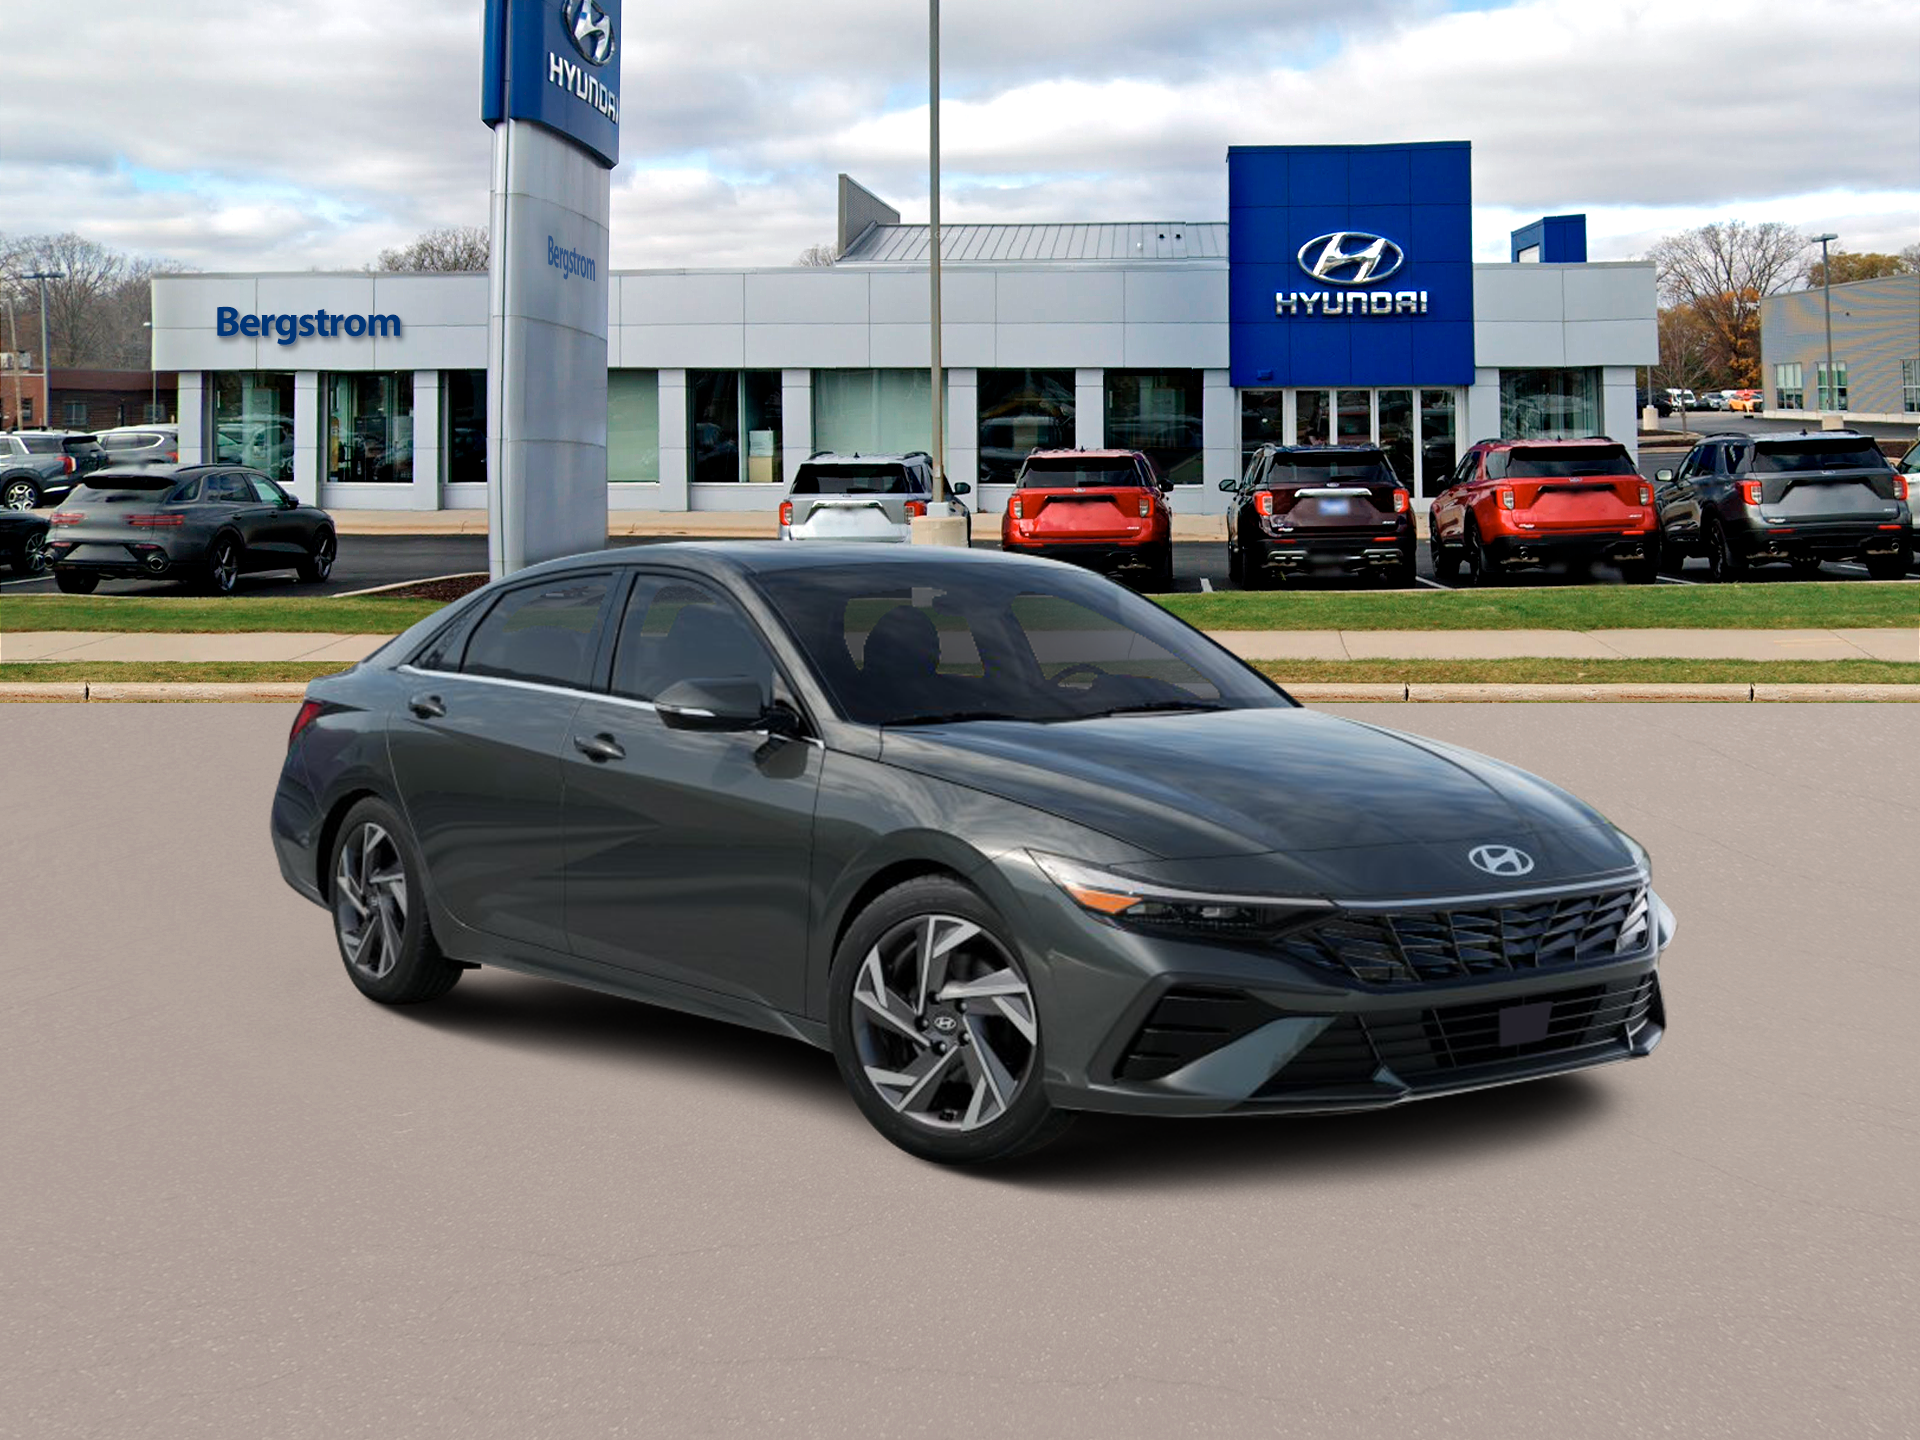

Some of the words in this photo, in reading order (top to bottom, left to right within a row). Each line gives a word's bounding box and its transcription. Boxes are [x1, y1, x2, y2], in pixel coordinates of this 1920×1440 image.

[548, 51, 618, 124] HYUNDAI
[547, 235, 596, 282] Bergstrom
[1275, 290, 1428, 315] HYUNDAI
[216, 306, 401, 346] Bergstrom
